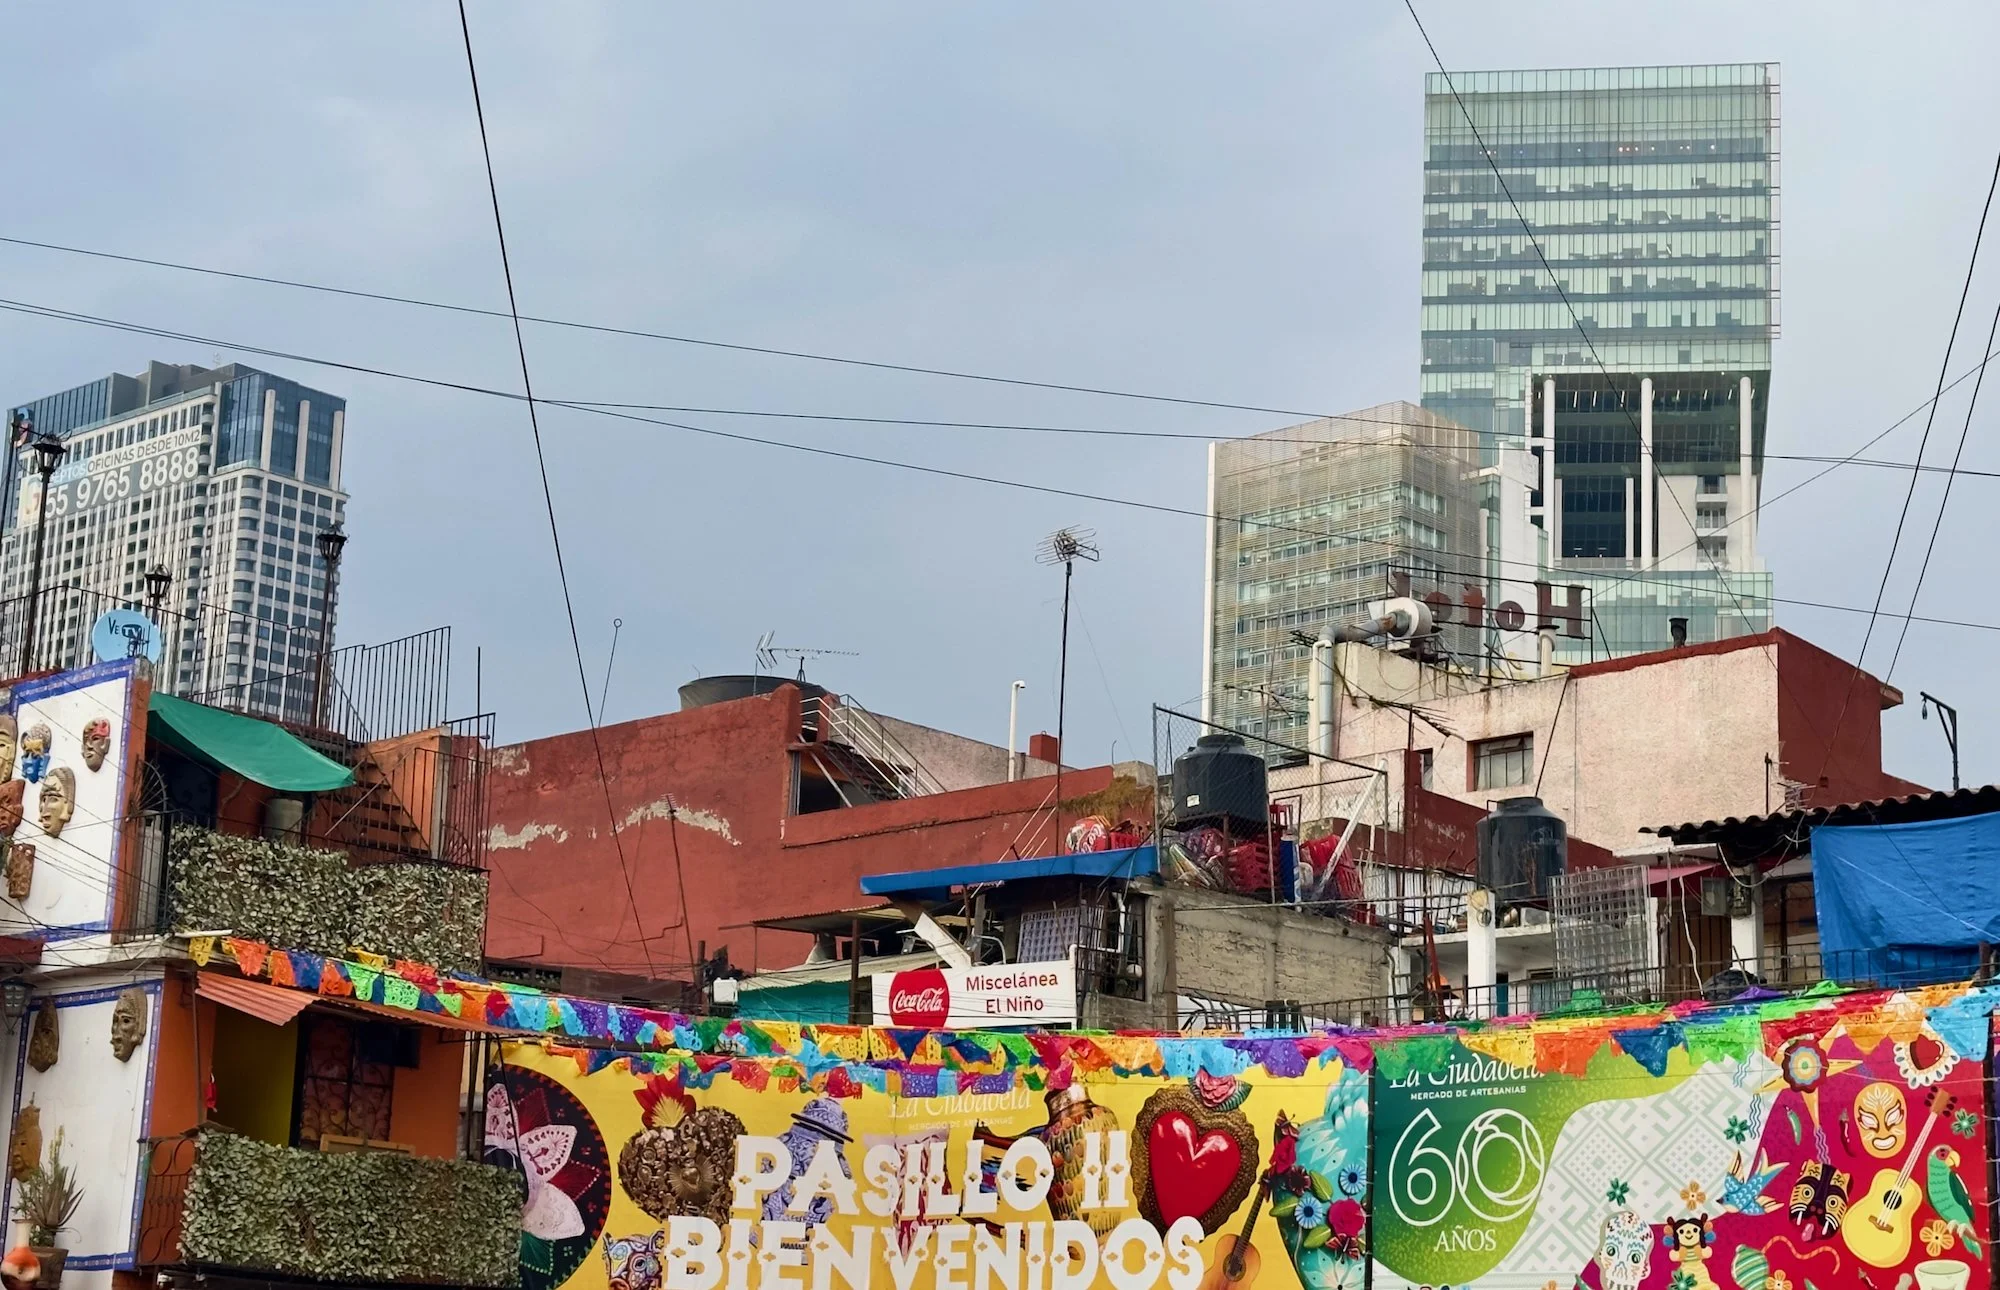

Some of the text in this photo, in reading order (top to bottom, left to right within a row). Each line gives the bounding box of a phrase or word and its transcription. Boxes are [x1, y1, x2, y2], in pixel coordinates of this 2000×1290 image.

[87, 448, 135, 473] OFICINAS
[137, 438, 172, 458] DESDE
[174, 429, 200, 447] 10M2
[45, 446, 199, 518] 55 9765 8888
[966, 971, 1058, 992] Miscelánea
[892, 987, 944, 1013] Coca-Cola
[986, 995, 1044, 1014] El Niño
[1410, 1085, 1527, 1100] MERCADO DE ARTESANIAS
[729, 1134, 1054, 1217] PASILLO
[1389, 1107, 1545, 1226] 60
[663, 1215, 1205, 1290] BIENVENIDOS
[1433, 1224, 1497, 1252] AÑOS
